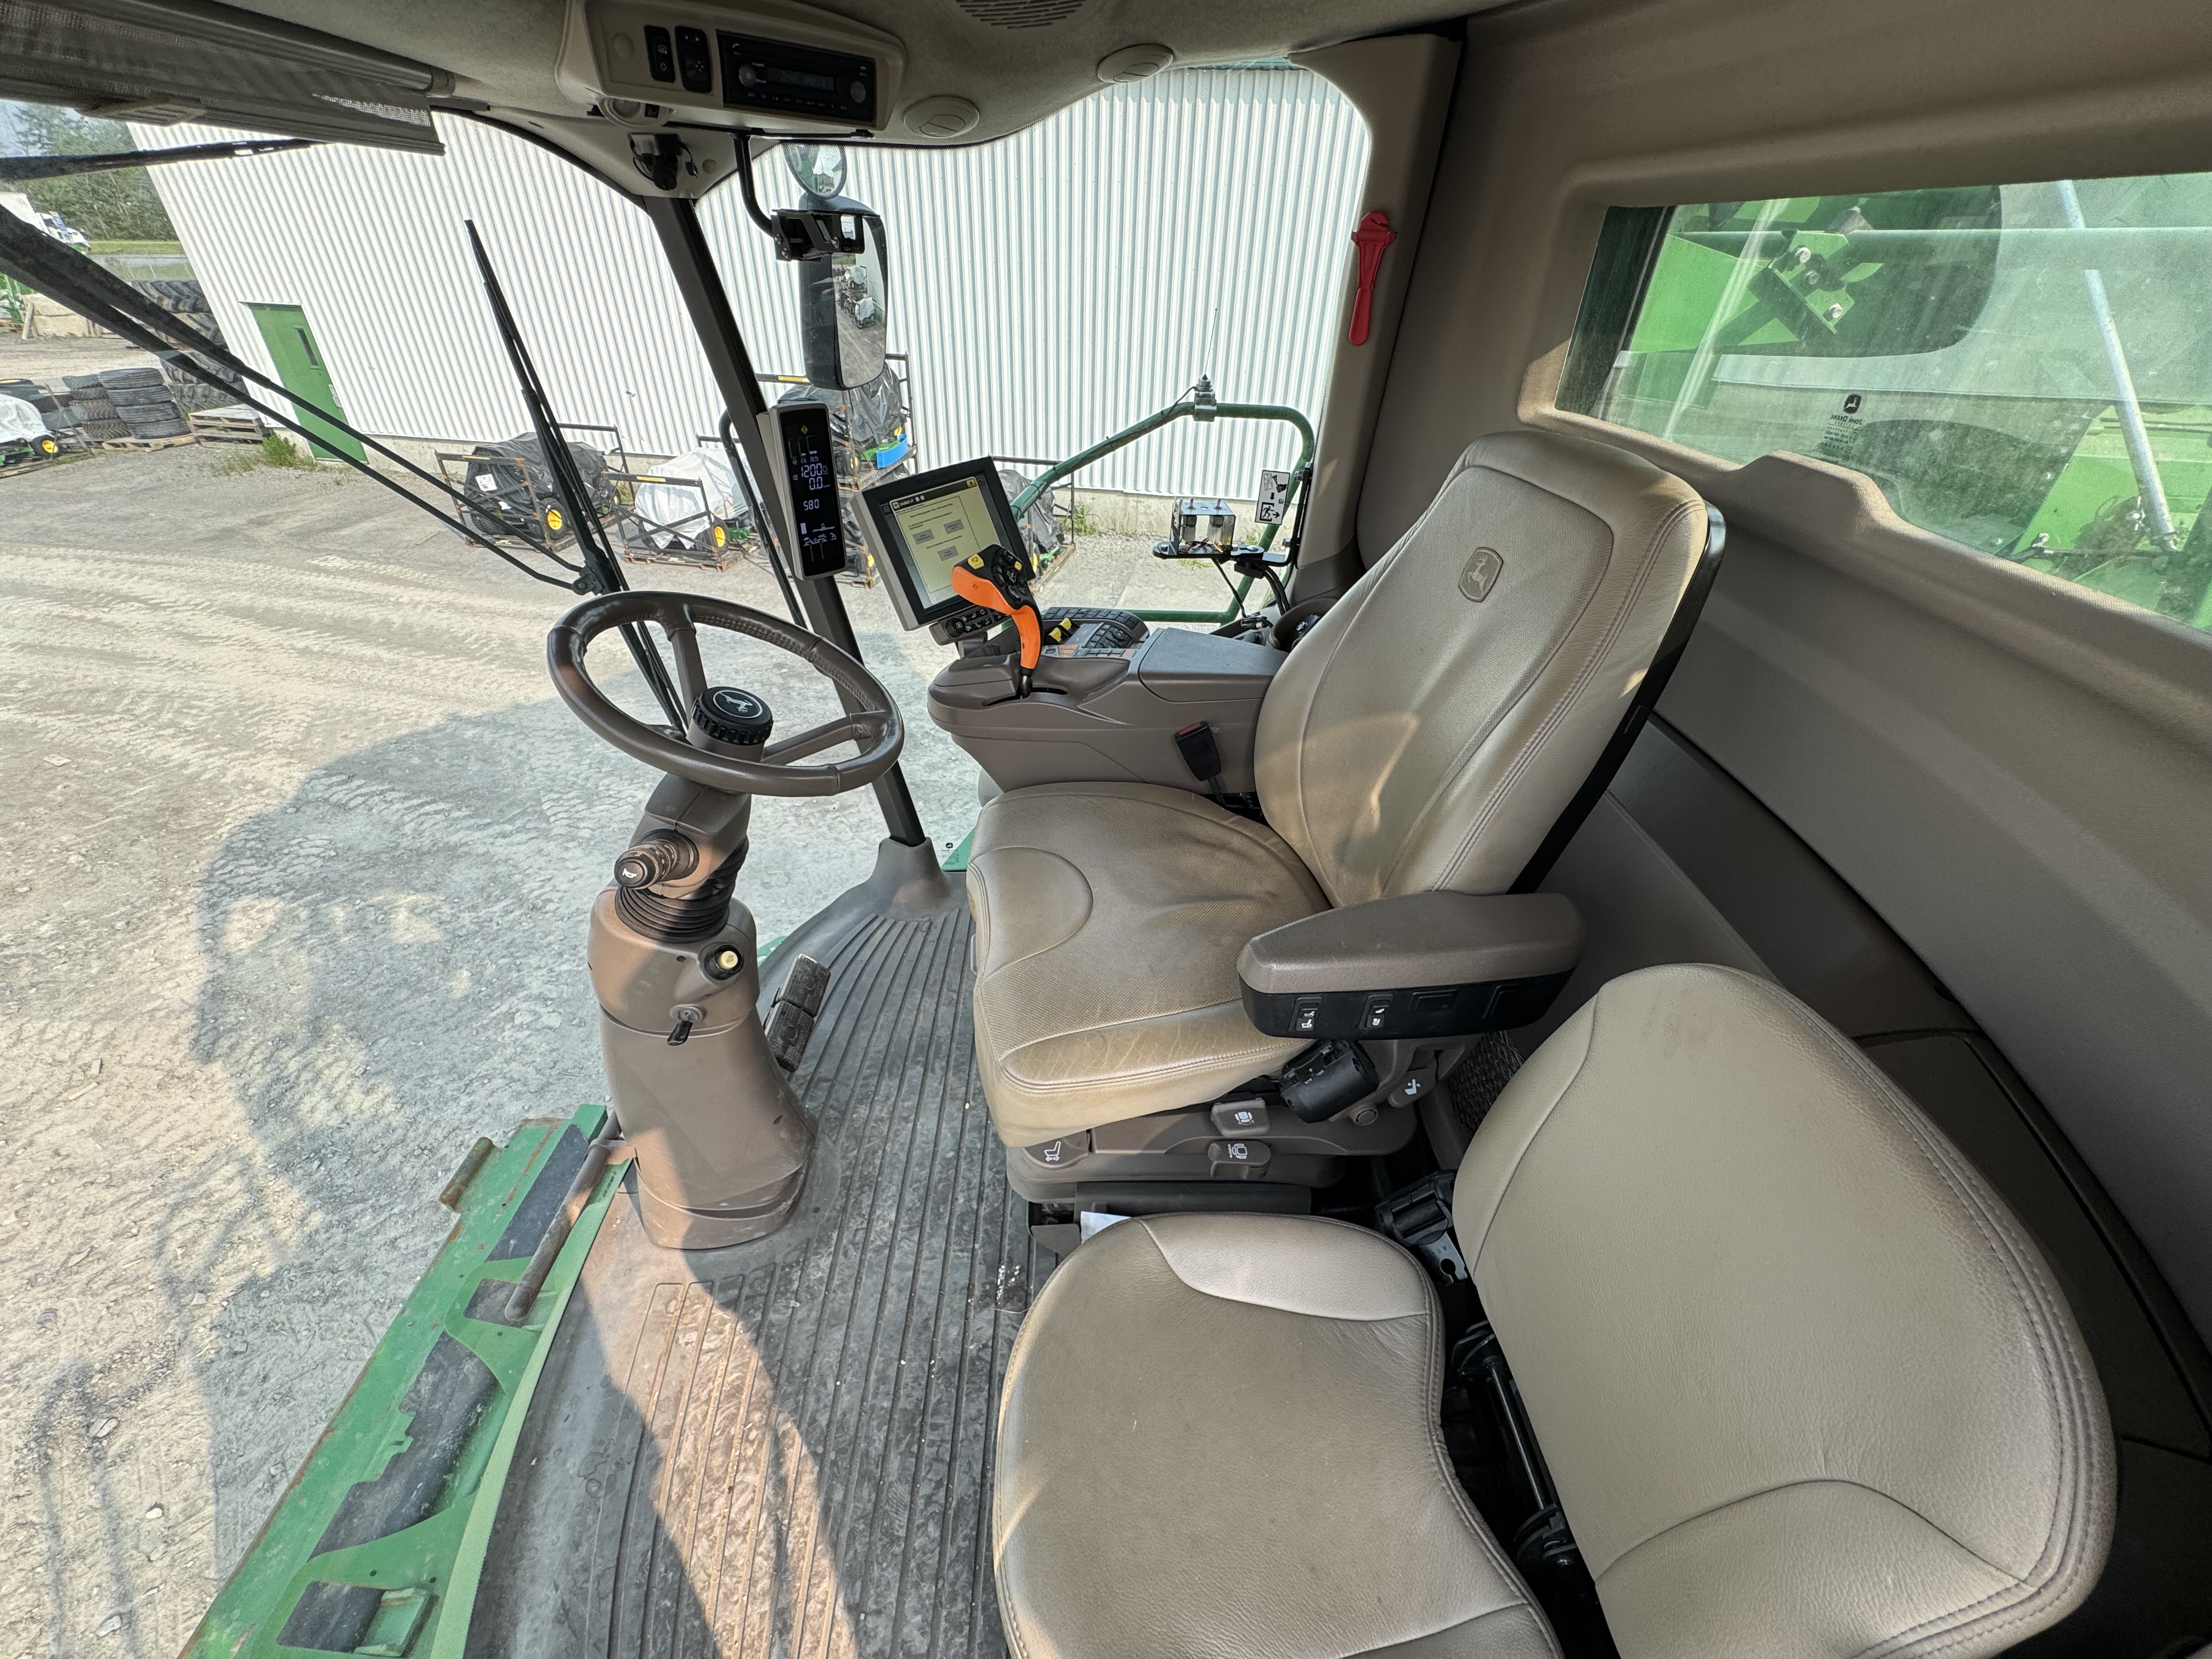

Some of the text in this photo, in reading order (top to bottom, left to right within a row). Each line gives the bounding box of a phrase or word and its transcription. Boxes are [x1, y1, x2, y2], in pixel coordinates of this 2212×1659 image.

[801, 463, 823, 478] 1200
[809, 476, 823, 490] 0.0
[803, 499, 820, 511] 580
